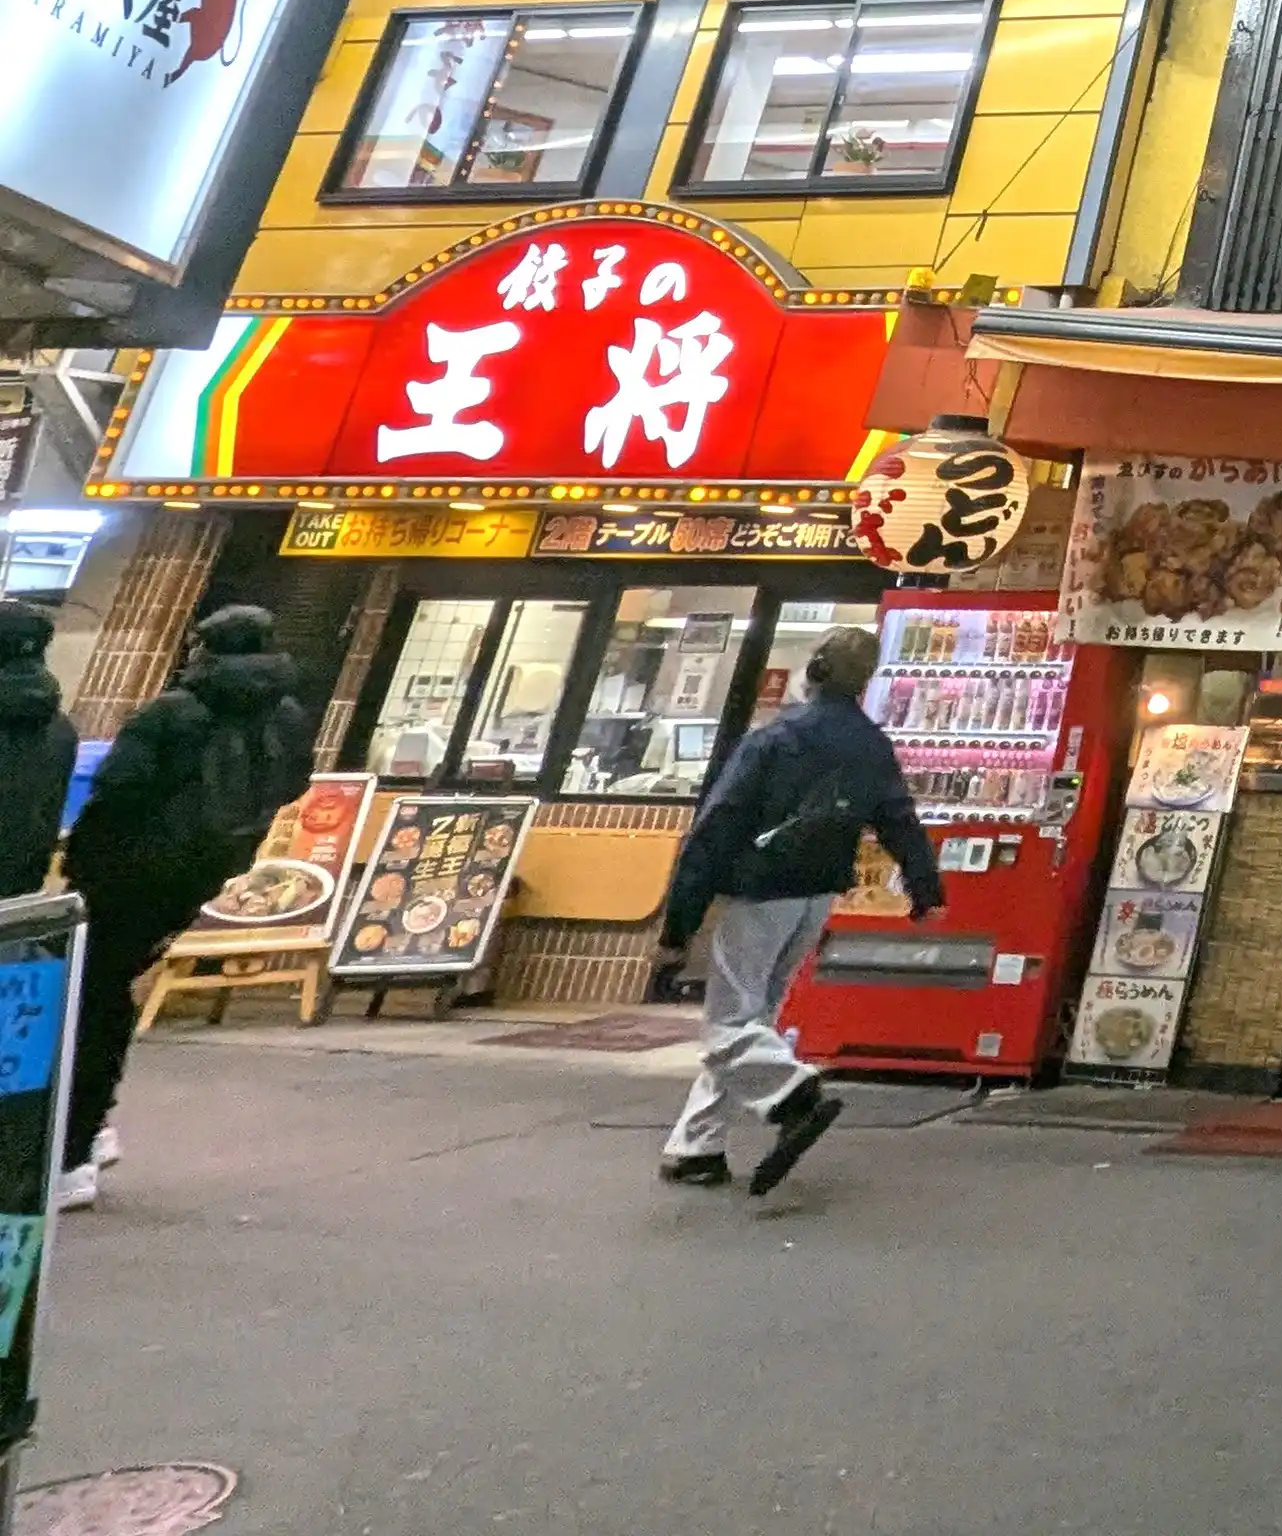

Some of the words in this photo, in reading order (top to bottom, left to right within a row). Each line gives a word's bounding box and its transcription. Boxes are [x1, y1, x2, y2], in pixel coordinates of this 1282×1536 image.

[498, 242, 687, 312] 餃子の
[377, 312, 736, 470] 王将
[299, 513, 344, 531] TAKE
[906, 438, 1018, 568] うどん
[295, 530, 334, 548] OUT
[341, 517, 531, 549] お持ち帰りコーナー
